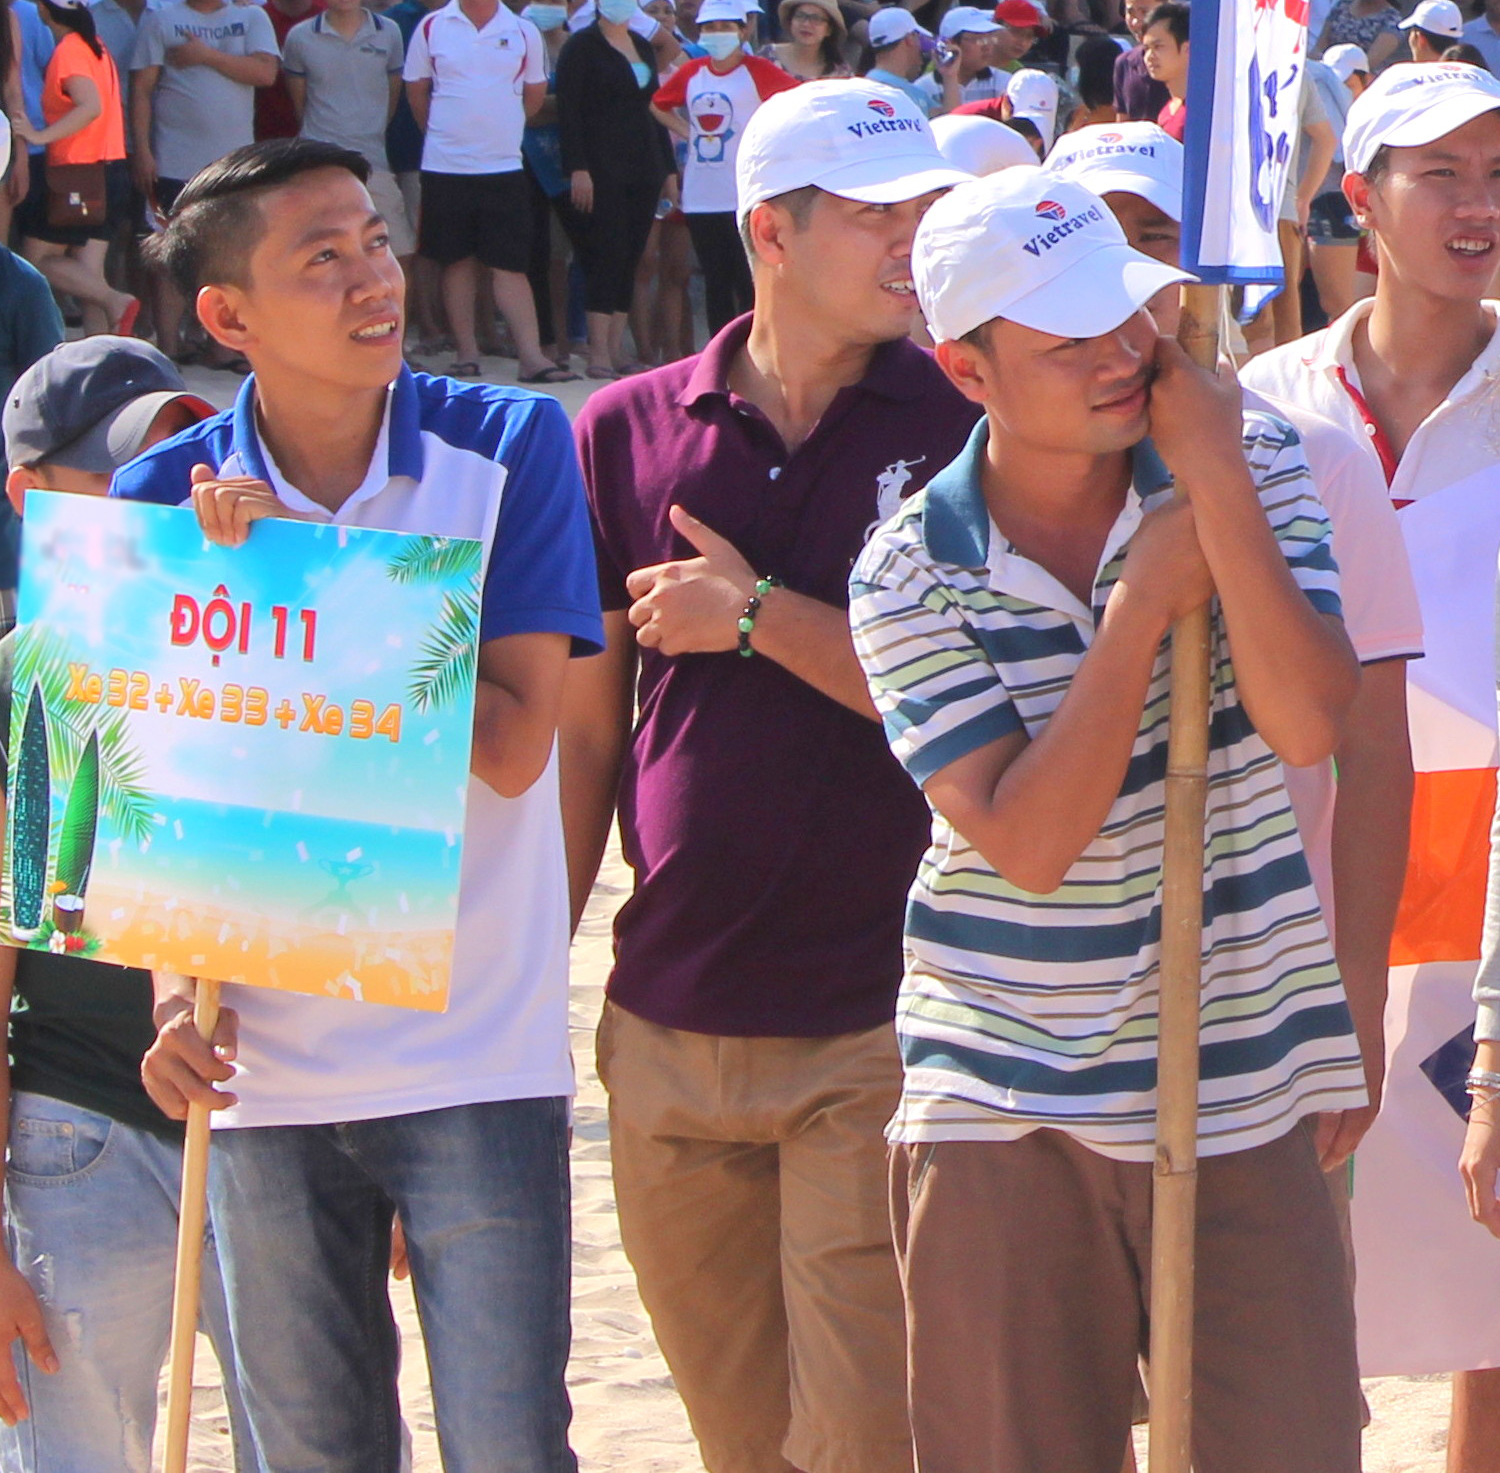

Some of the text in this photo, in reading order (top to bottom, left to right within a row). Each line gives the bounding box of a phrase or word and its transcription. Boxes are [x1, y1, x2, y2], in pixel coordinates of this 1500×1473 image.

[1064, 144, 1155, 168] Vietravel
[1023, 204, 1104, 257] Vietravel
[170, 583, 317, 666] ĐỘI 11
[65, 662, 402, 743] Xe 32 + Xe 33 + Xe 34
